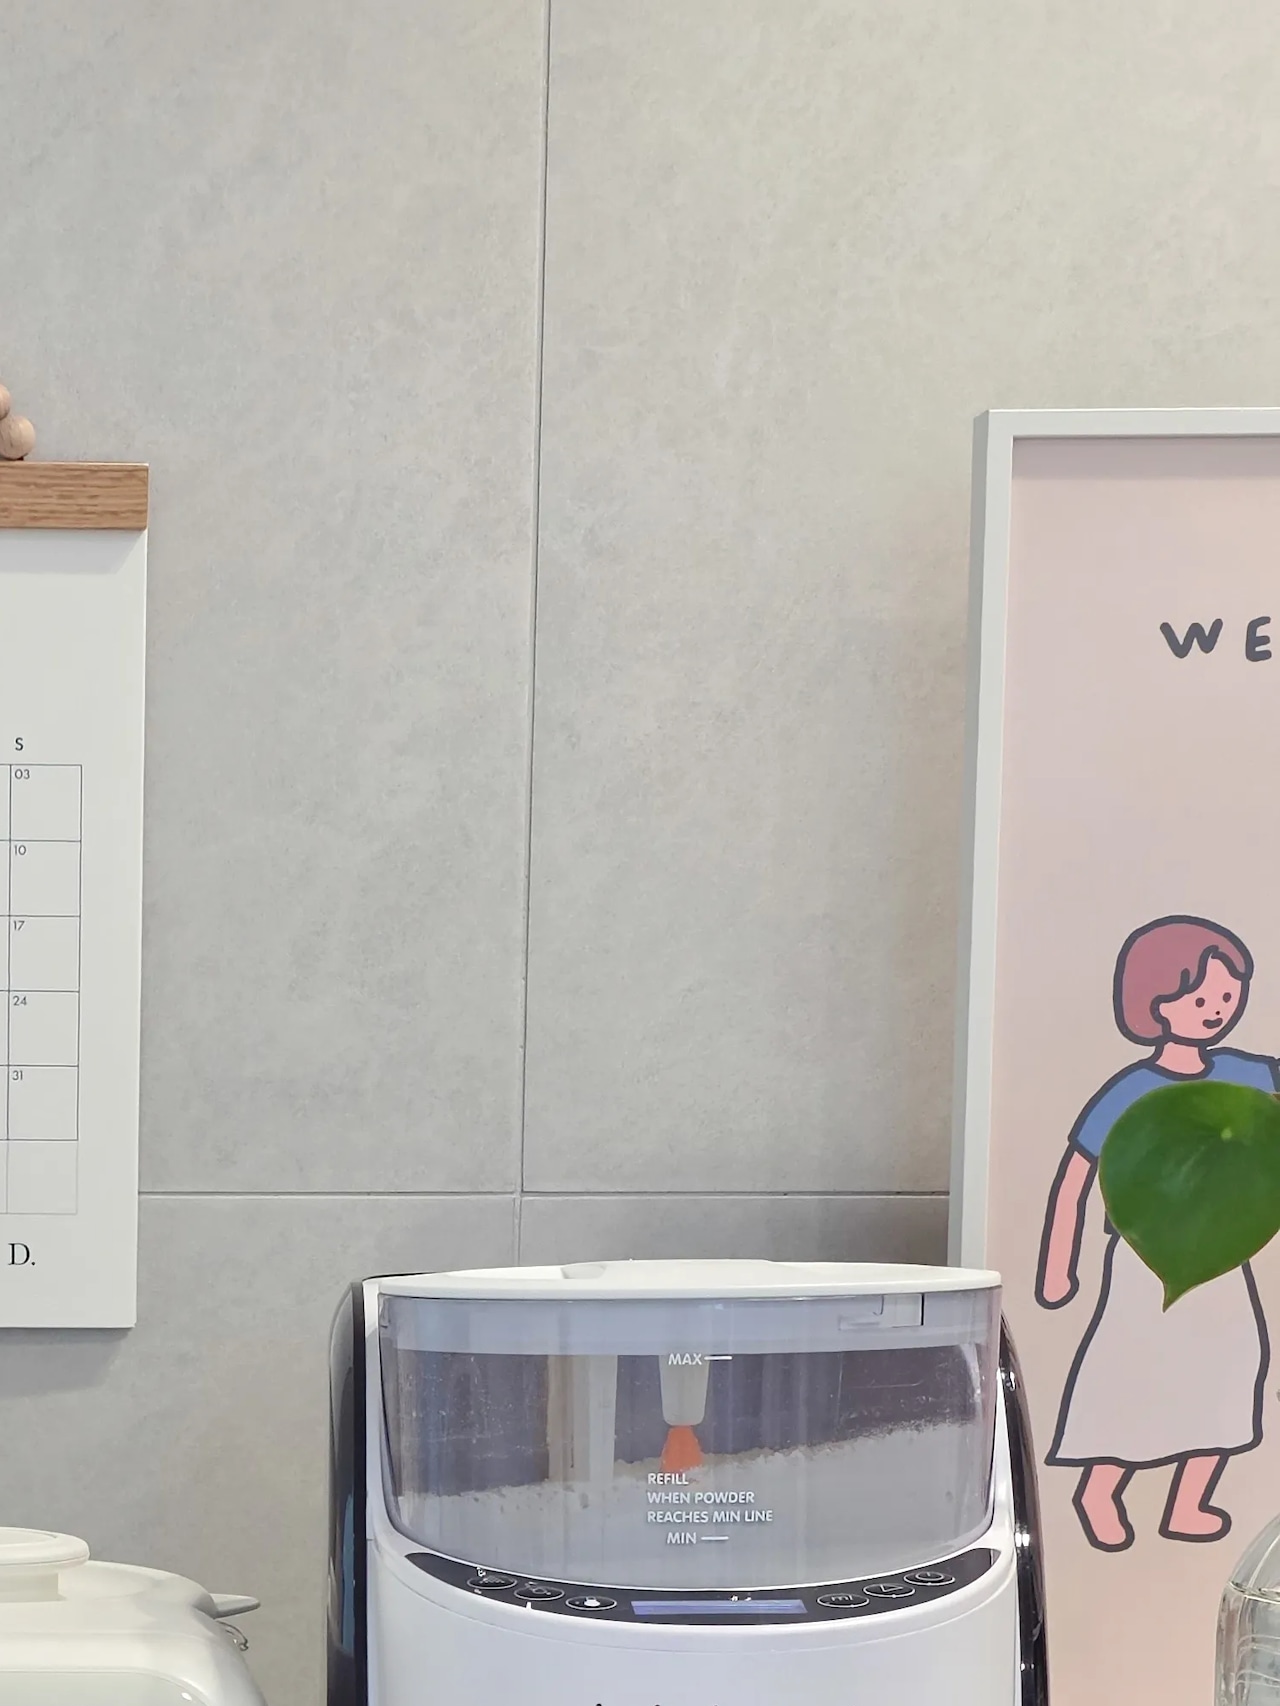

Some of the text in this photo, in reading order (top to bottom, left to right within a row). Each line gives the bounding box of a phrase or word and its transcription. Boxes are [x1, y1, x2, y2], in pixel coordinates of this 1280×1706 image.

[1158, 615, 1274, 664] WE
[15, 737, 24, 751] S
[14, 768, 31, 780] 03
[13, 844, 28, 856] 10
[12, 919, 26, 932] 17
[12, 995, 27, 1006] 24
[12, 1069, 23, 1081] 31
[8, 1242, 36, 1266] D.
[668, 1353, 702, 1365] MAX
[648, 1473, 689, 1485] REFILL
[647, 1491, 755, 1504] WHEN POWDER
[647, 1510, 773, 1523] REACHES MIN LINE
[667, 1532, 697, 1544] MIN
